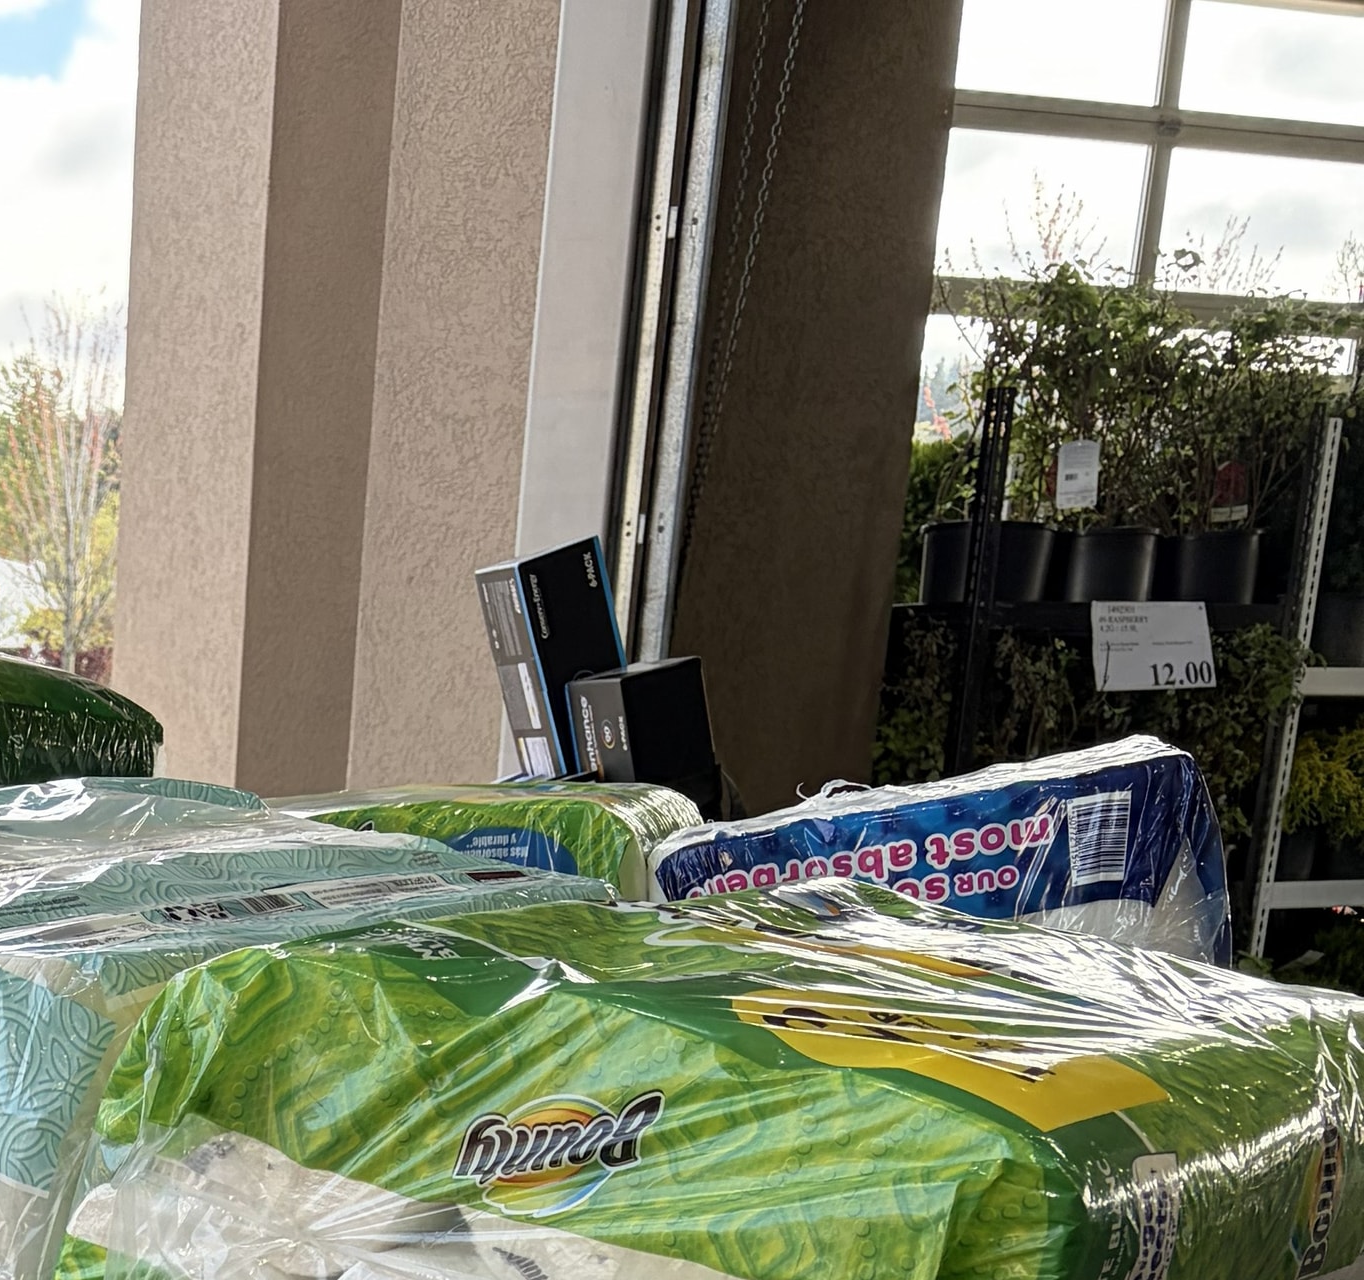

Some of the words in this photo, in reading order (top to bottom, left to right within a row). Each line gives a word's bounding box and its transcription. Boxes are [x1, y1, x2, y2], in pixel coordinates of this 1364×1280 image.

[1150, 661, 1212, 687] 12.00
[929, 814, 1051, 866] most
[453, 1088, 666, 1184] Bounty
